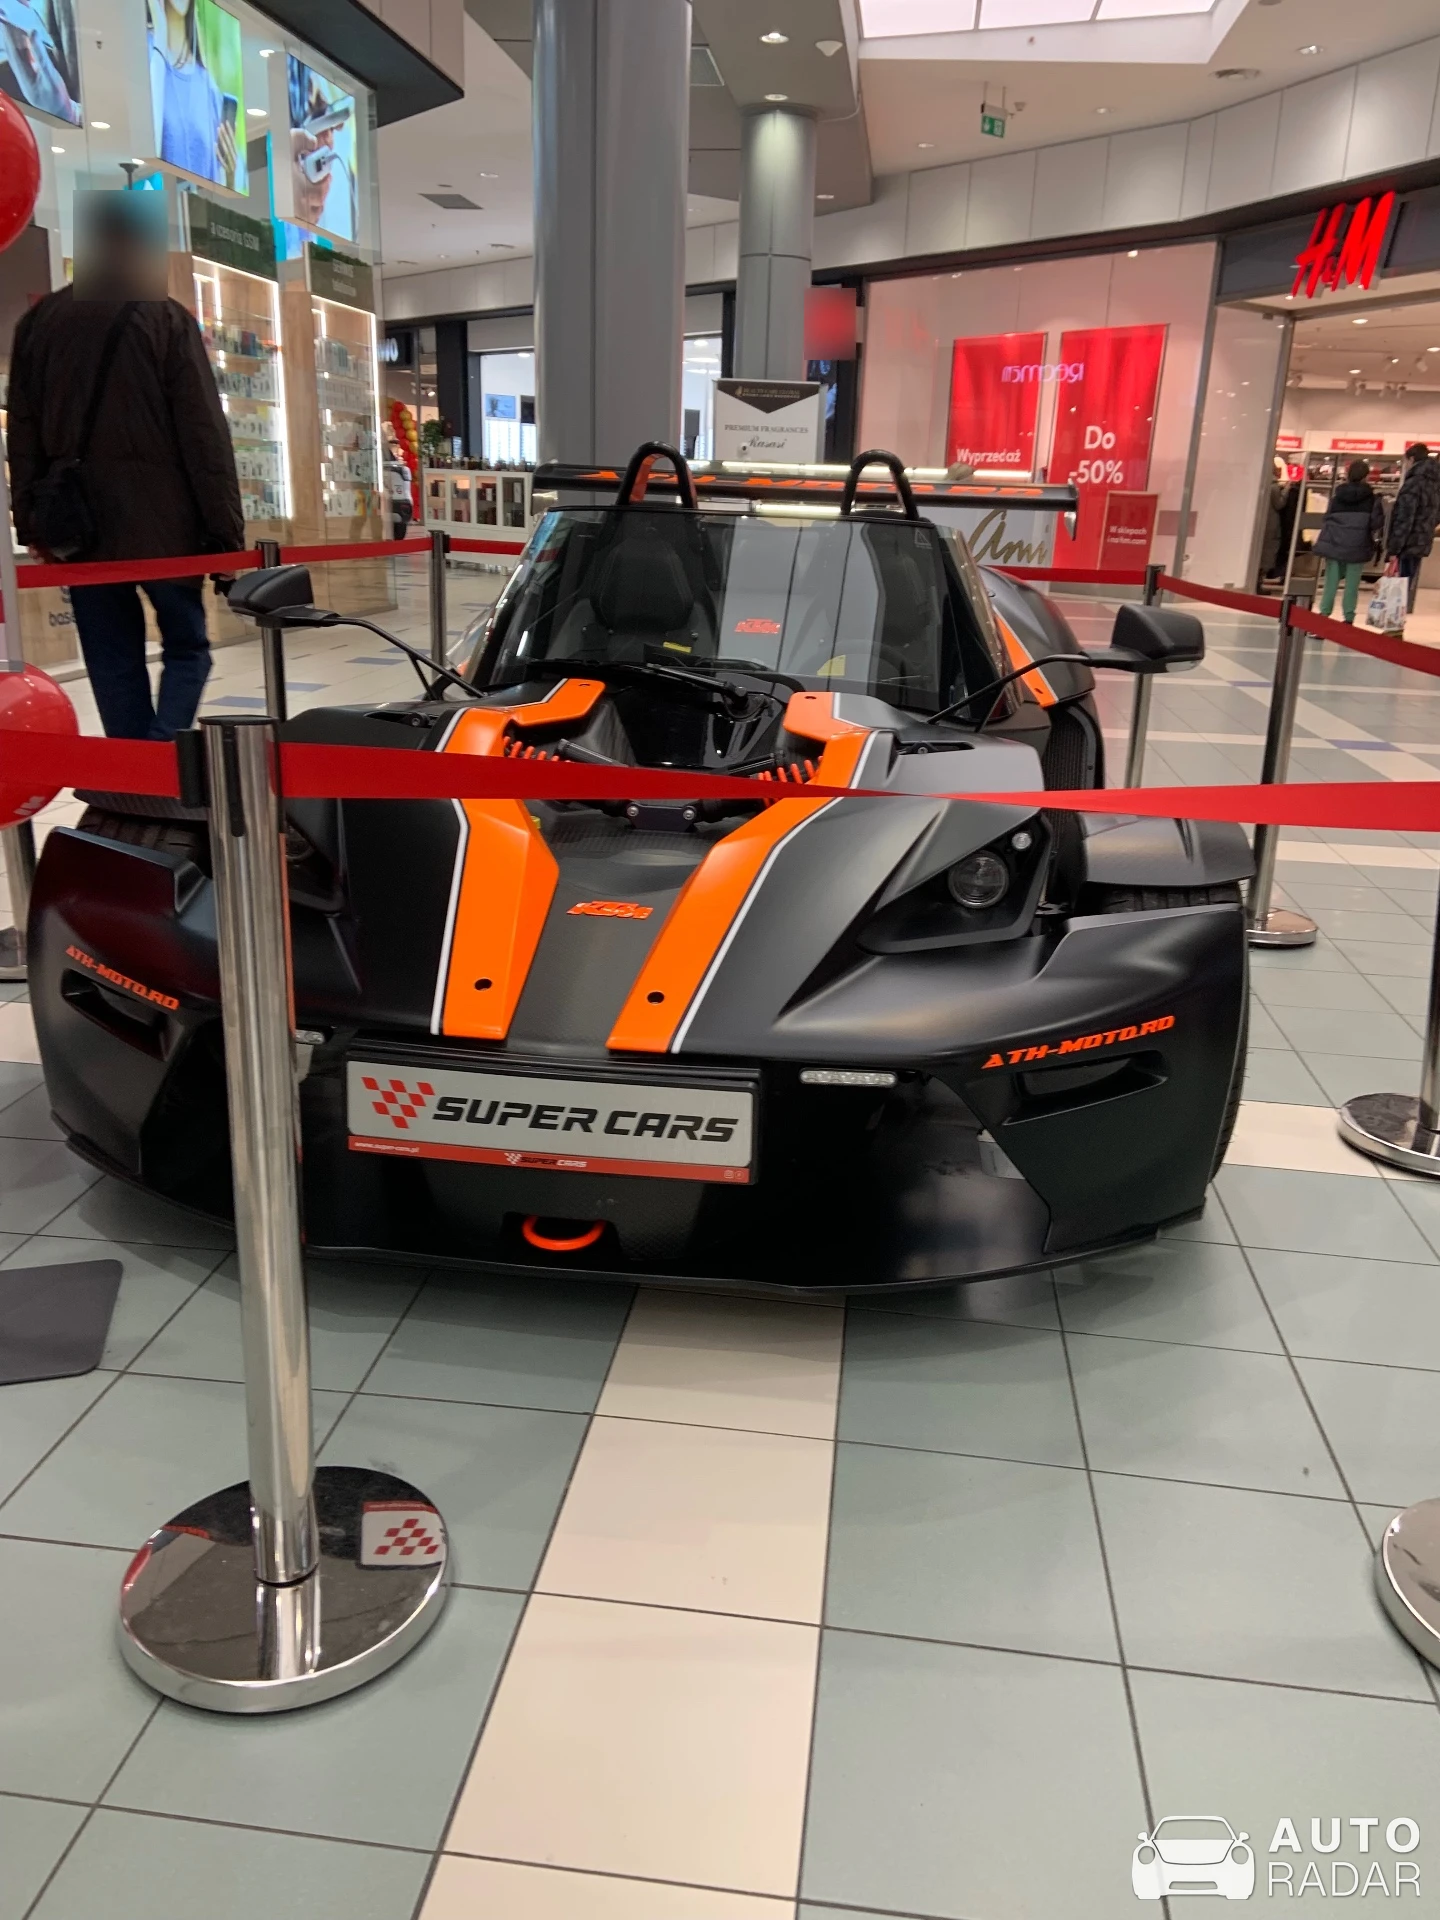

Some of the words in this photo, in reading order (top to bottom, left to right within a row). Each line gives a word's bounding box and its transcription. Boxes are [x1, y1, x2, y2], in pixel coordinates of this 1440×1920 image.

[1291, 189, 1396, 299] H&M
[724, 424, 760, 432] PREMIUM
[760, 425, 809, 434] FRAGRANCES
[1084, 425, 1116, 449] Do
[956, 448, 1021, 466] Wyprzedaż
[1068, 460, 1124, 484] -50%
[432, 1096, 598, 1133] SUPER
[603, 1109, 739, 1143] CARS
